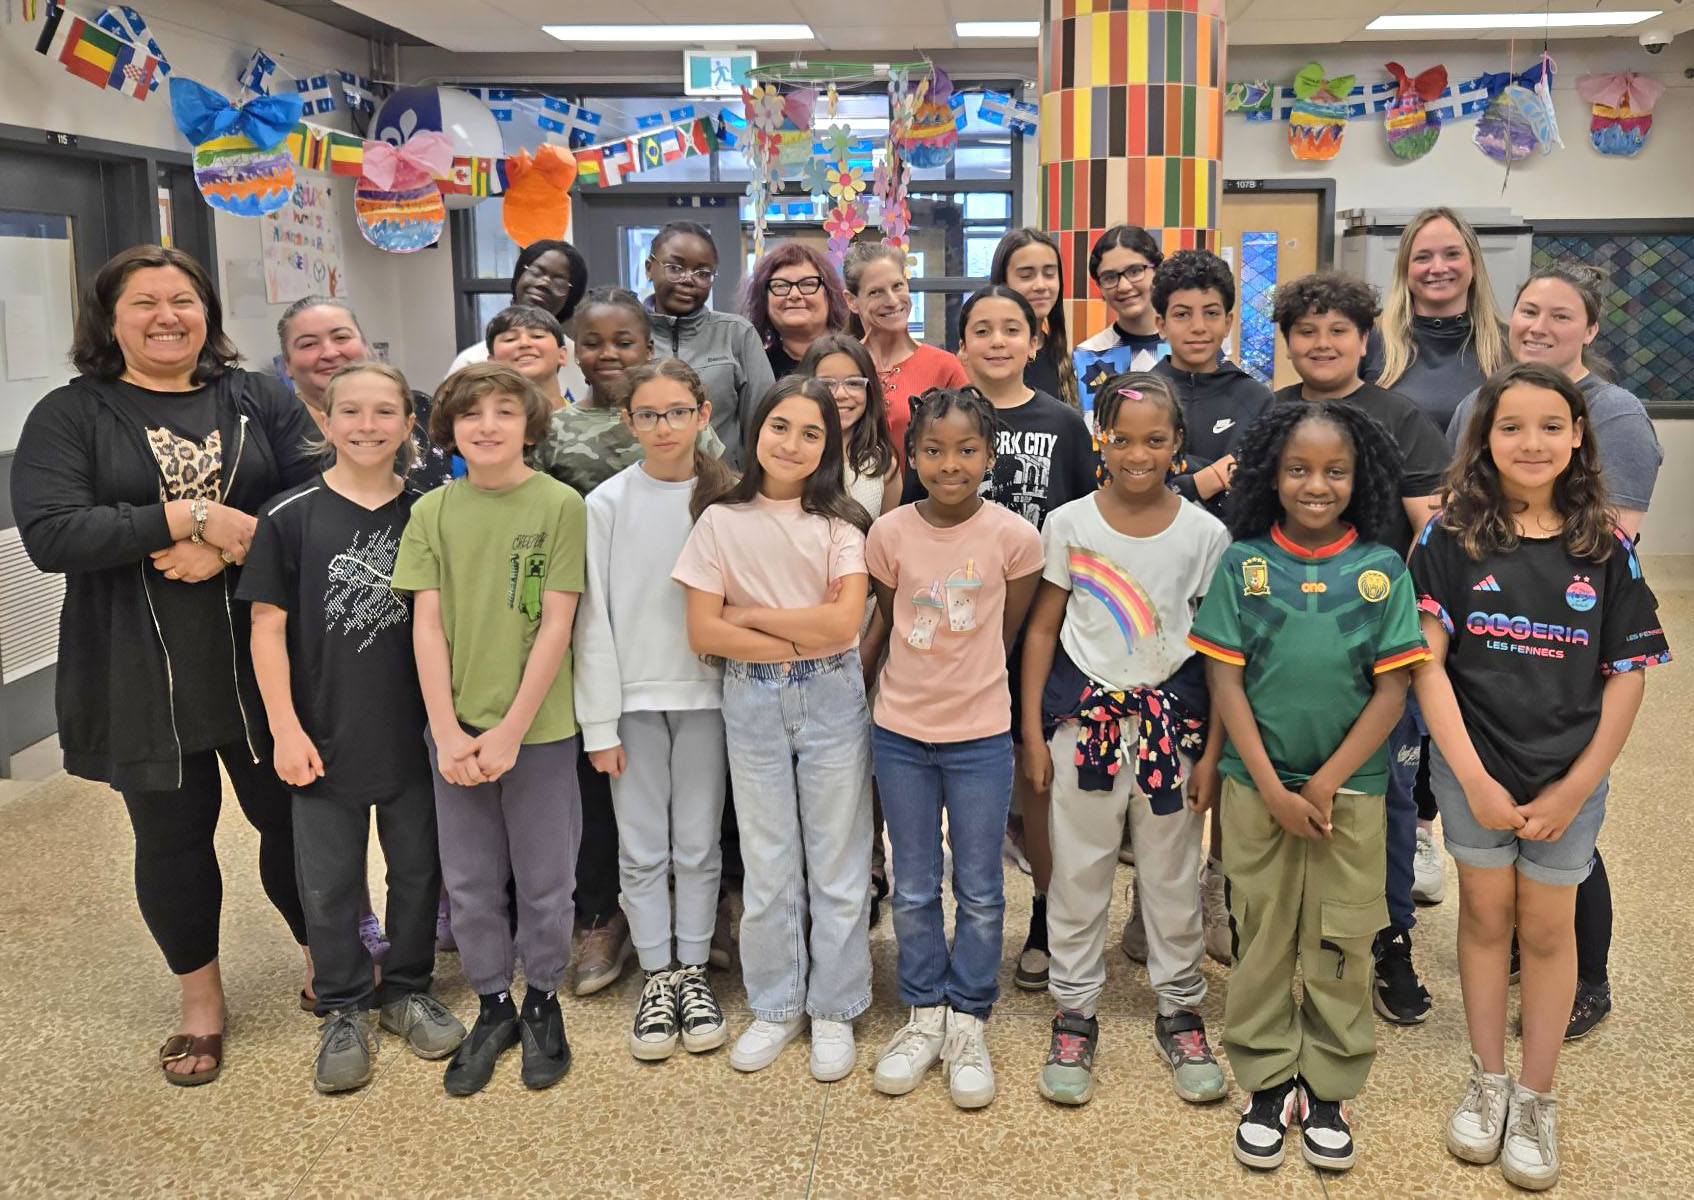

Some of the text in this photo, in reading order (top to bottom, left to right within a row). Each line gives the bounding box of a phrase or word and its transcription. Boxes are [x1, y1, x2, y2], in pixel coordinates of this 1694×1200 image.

[57, 133, 68, 145] 115
[1236, 180, 1257, 189] 107B
[996, 431, 1058, 458] RK CITY
[1466, 611, 1589, 646] ALGERIA
[1486, 640, 1565, 659] LES FENNECS
